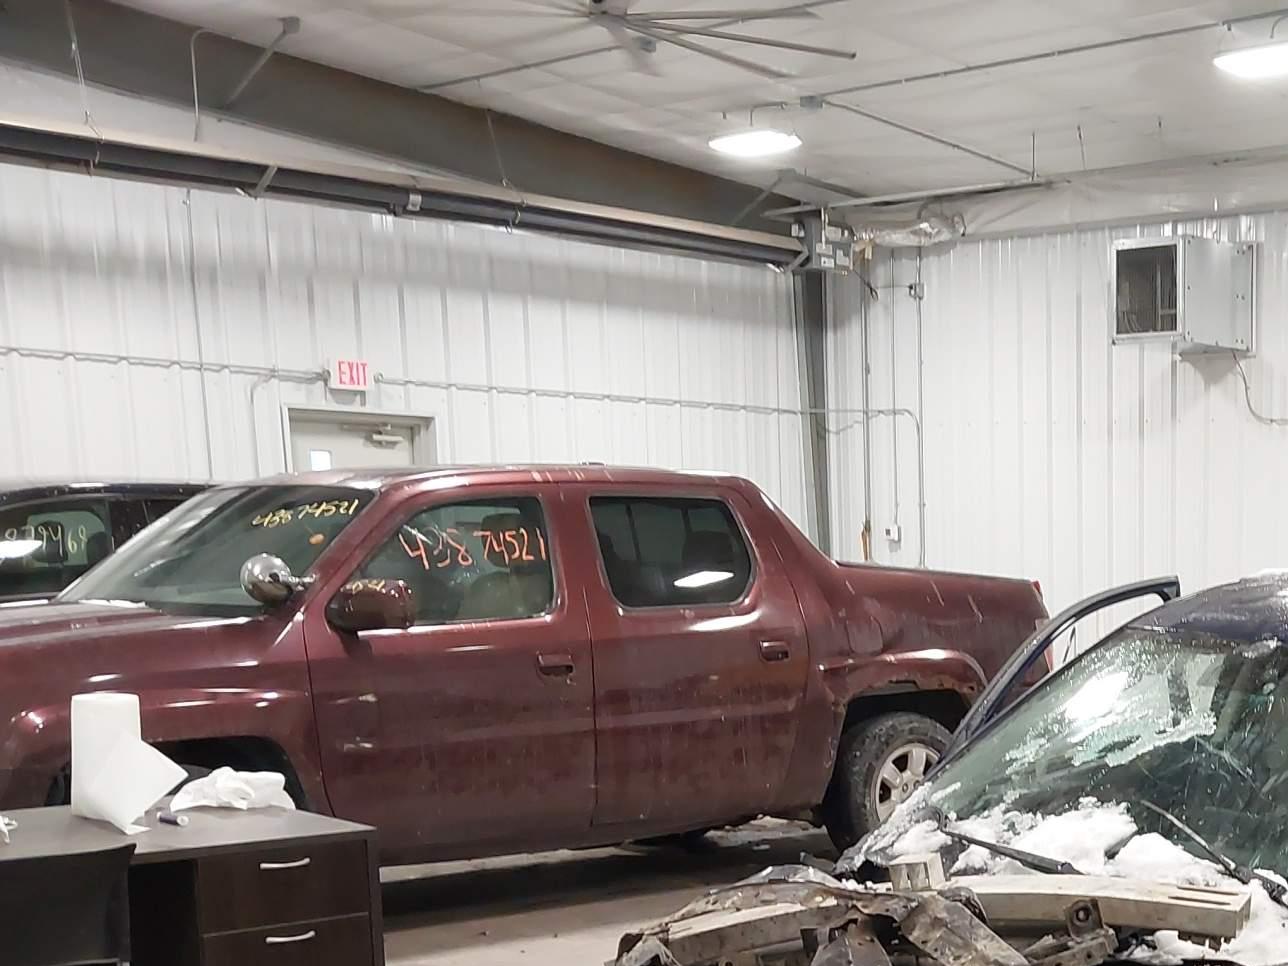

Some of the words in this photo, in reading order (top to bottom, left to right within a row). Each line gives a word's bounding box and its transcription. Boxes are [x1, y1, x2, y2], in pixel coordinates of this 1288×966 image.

[338, 360, 367, 386] EXIT
[298, 499, 359, 519] 74521
[473, 526, 546, 566] 74521
